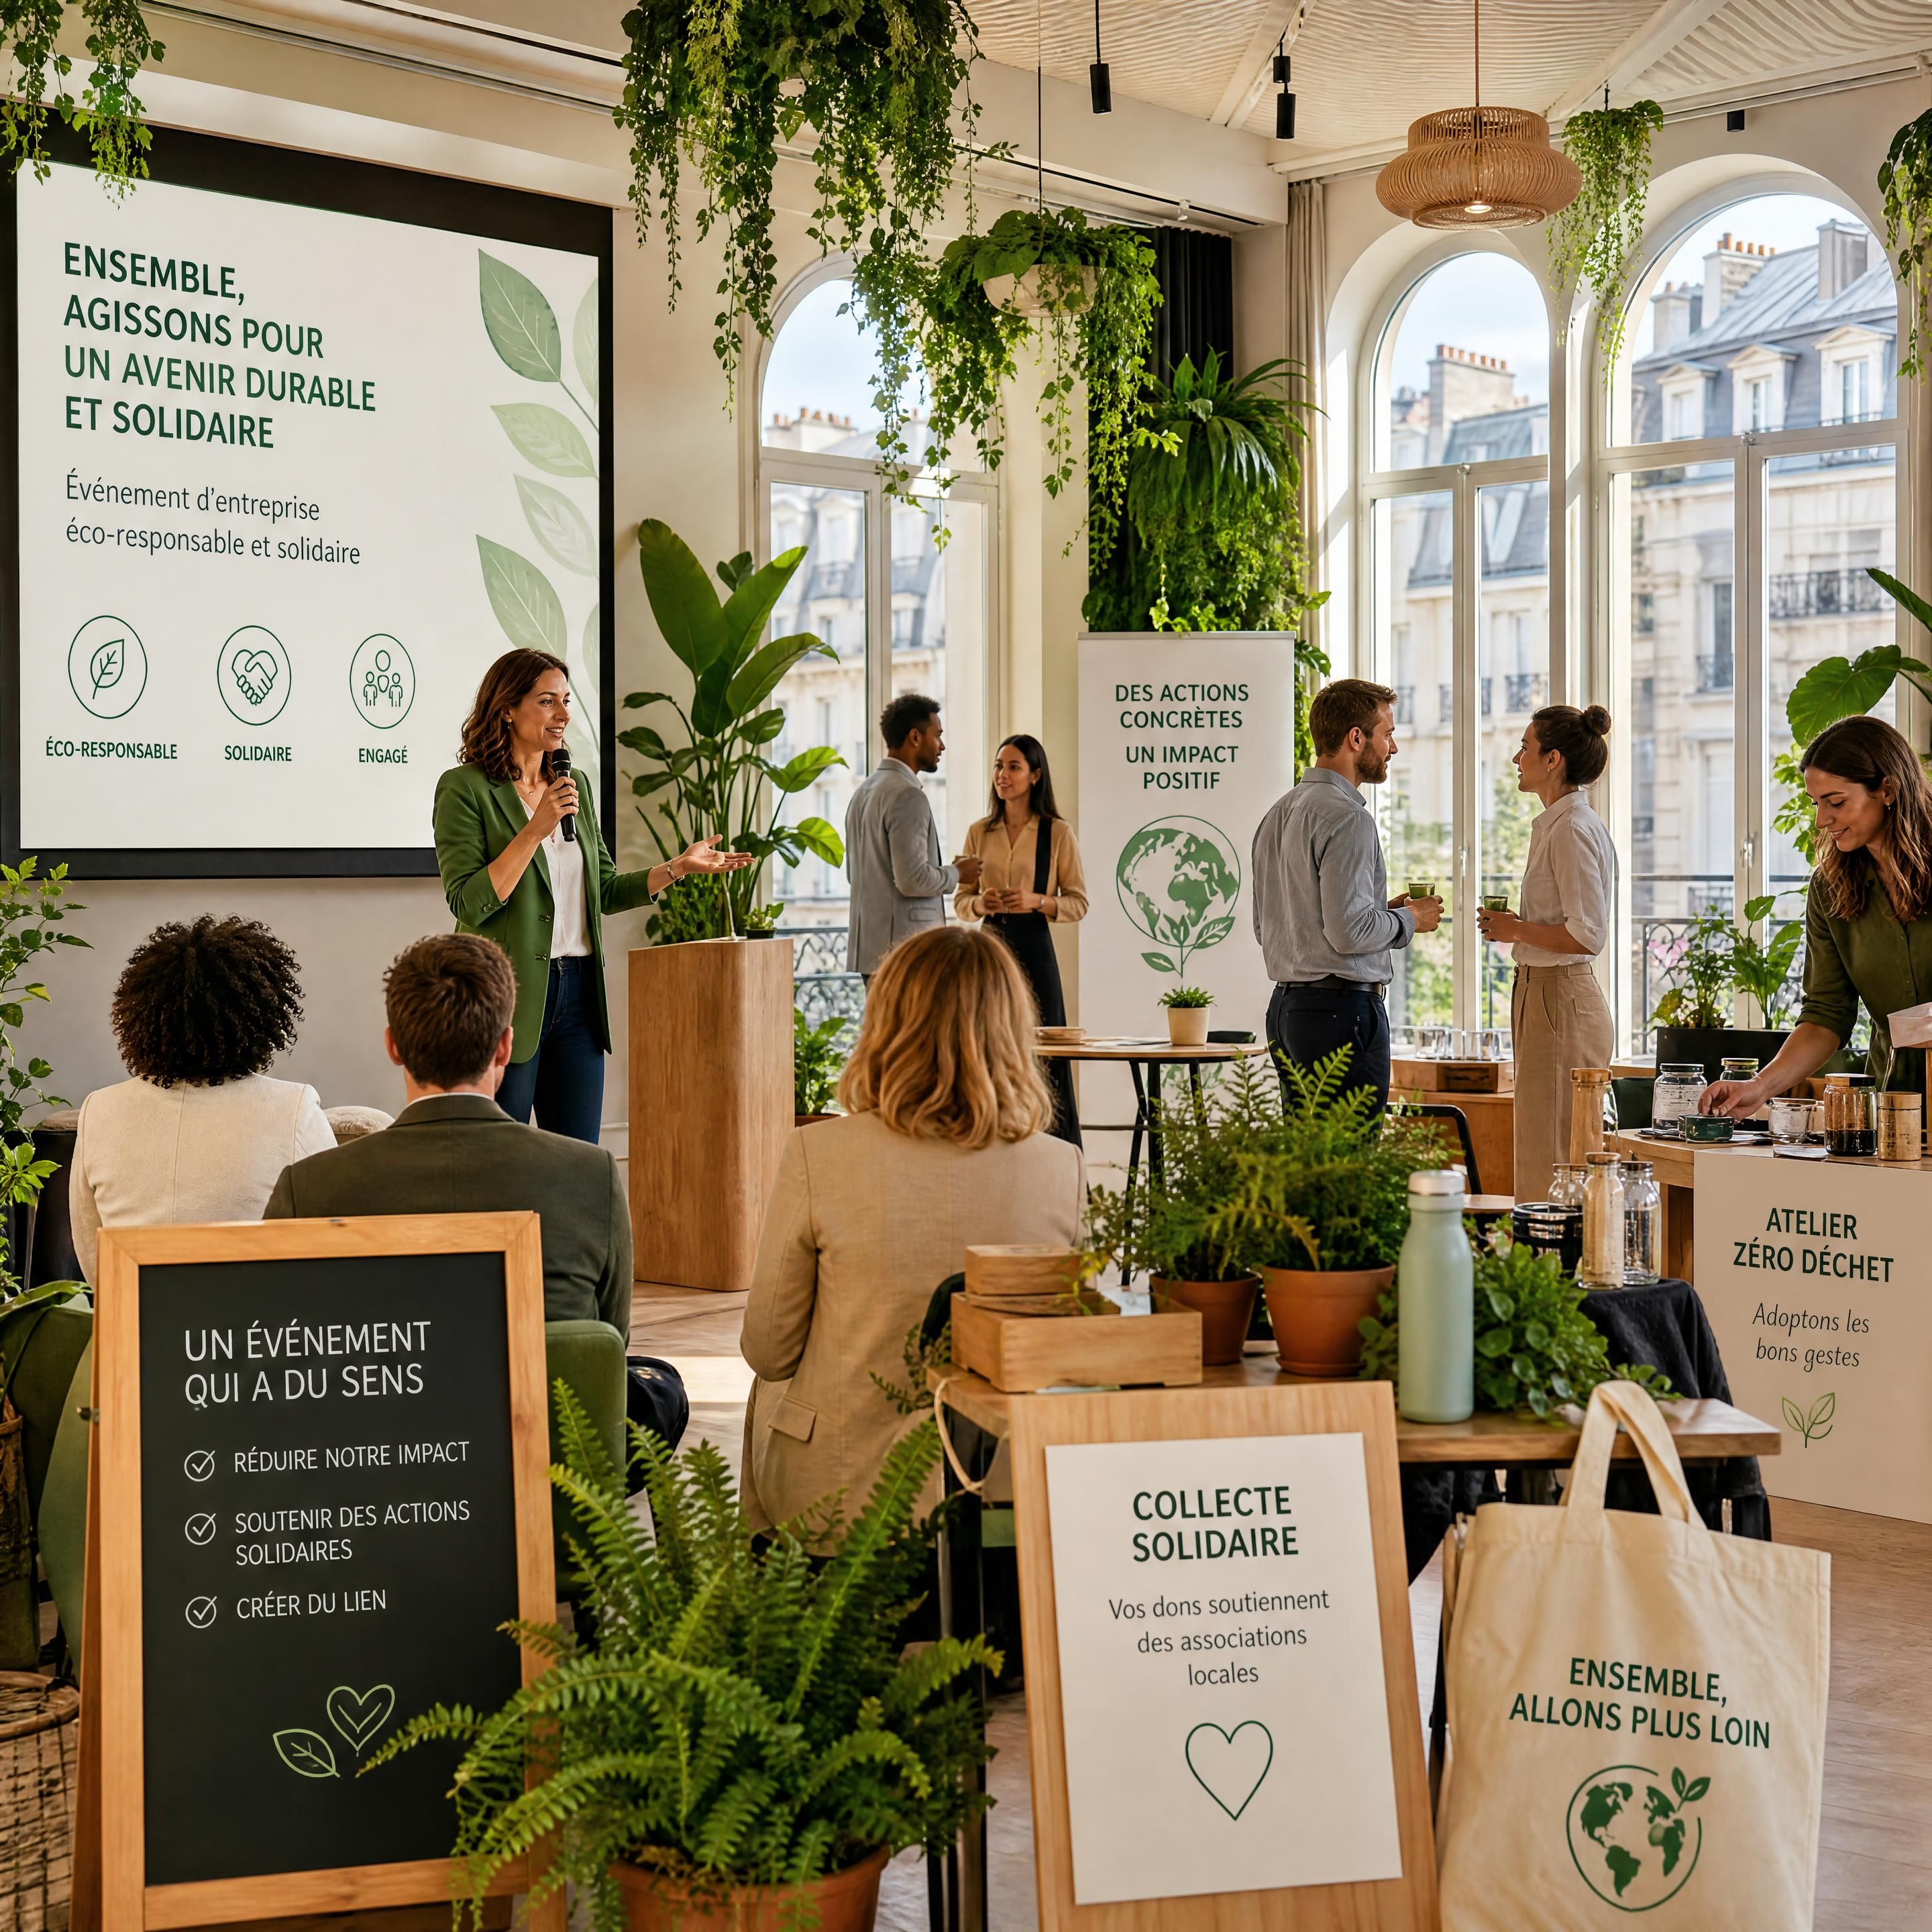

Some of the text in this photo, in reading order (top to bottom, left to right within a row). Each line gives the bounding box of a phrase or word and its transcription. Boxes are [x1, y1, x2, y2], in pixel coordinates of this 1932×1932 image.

[64, 241, 244, 306] ENSEMBLE,
[63, 294, 324, 359] AGISSONS POUR
[65, 345, 376, 412] UN AVENIR DURABLE
[66, 395, 274, 449] ET SOLIDAIRE
[66, 468, 190, 510] Événement
[66, 517, 360, 565] éco-responsable et solidaire
[1116, 684, 1249, 702] DES ACTIONS
[1120, 706, 1243, 729] CONCRÈTES
[46, 735, 178, 759] ÉCO-RESPONSABLE
[224, 745, 292, 762] SOLIDAIRE
[359, 745, 408, 763] ENGAGÉ
[1126, 745, 1239, 763] UN IMPACT
[1143, 771, 1220, 790] POSITIF
[1766, 1207, 1858, 1240] ATELIER
[1733, 1236, 1894, 1283] ZÉRO DÉCHET
[1752, 1302, 1869, 1337] Adoptons les
[185, 1318, 431, 1362] UN ÉVÉNEMENT
[1756, 1337, 1860, 1373] bons gestes
[185, 1362, 423, 1408] QUI A DU SENS
[235, 1441, 470, 1473] RÉDUIRE NOTRE IMPACT
[235, 1500, 470, 1534] SOUTENIR DES ACTIONS
[1133, 1486, 1291, 1521] COLLECTE
[236, 1538, 352, 1566] SOLIDAIRES
[1132, 1526, 1299, 1562] SOLIDAIRE
[237, 1589, 386, 1619] CRÉER DU LIEN
[1108, 1590, 1330, 1620] Vos dons soutiennent
[1137, 1626, 1307, 1654] des associations
[1188, 1661, 1259, 1686] locales
[1570, 1657, 1727, 1708] ENSEMBLE,
[1509, 1693, 1770, 1749] ALLONS PLUS LOIN
